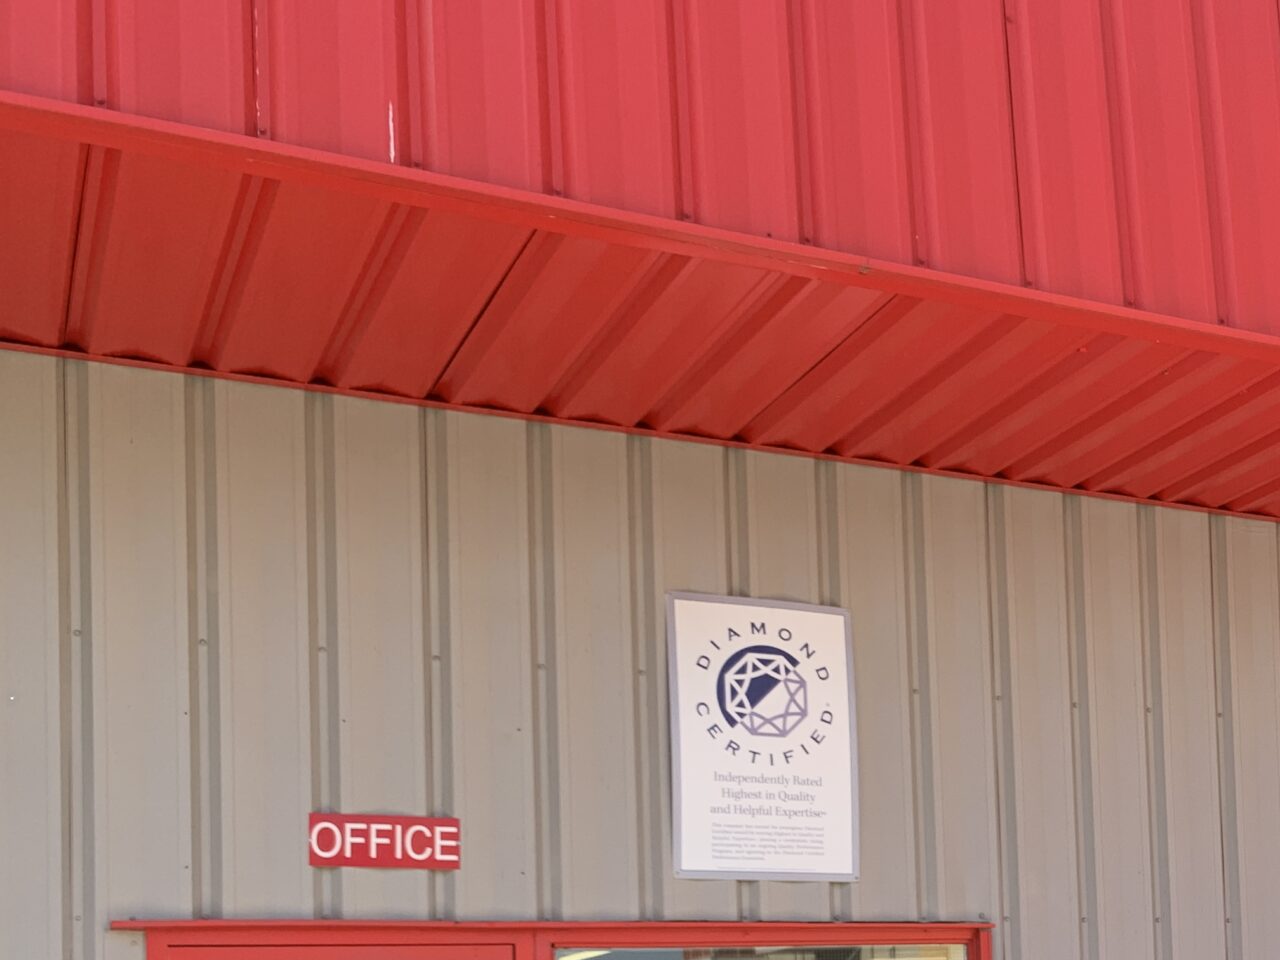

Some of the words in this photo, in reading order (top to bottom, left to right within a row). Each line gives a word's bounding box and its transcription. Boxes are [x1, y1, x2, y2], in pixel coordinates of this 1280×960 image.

[696, 622, 830, 682] DIAMOND
[696, 702, 834, 767] CERTIFIED
[713, 770, 790, 788] Independently
[792, 775, 823, 787] Rated
[721, 787, 762, 801] Highest
[765, 790, 776, 800] in
[777, 790, 816, 805] Quality
[709, 804, 731, 814] and
[733, 804, 773, 818] Helpful
[310, 821, 460, 861] OFFICE
